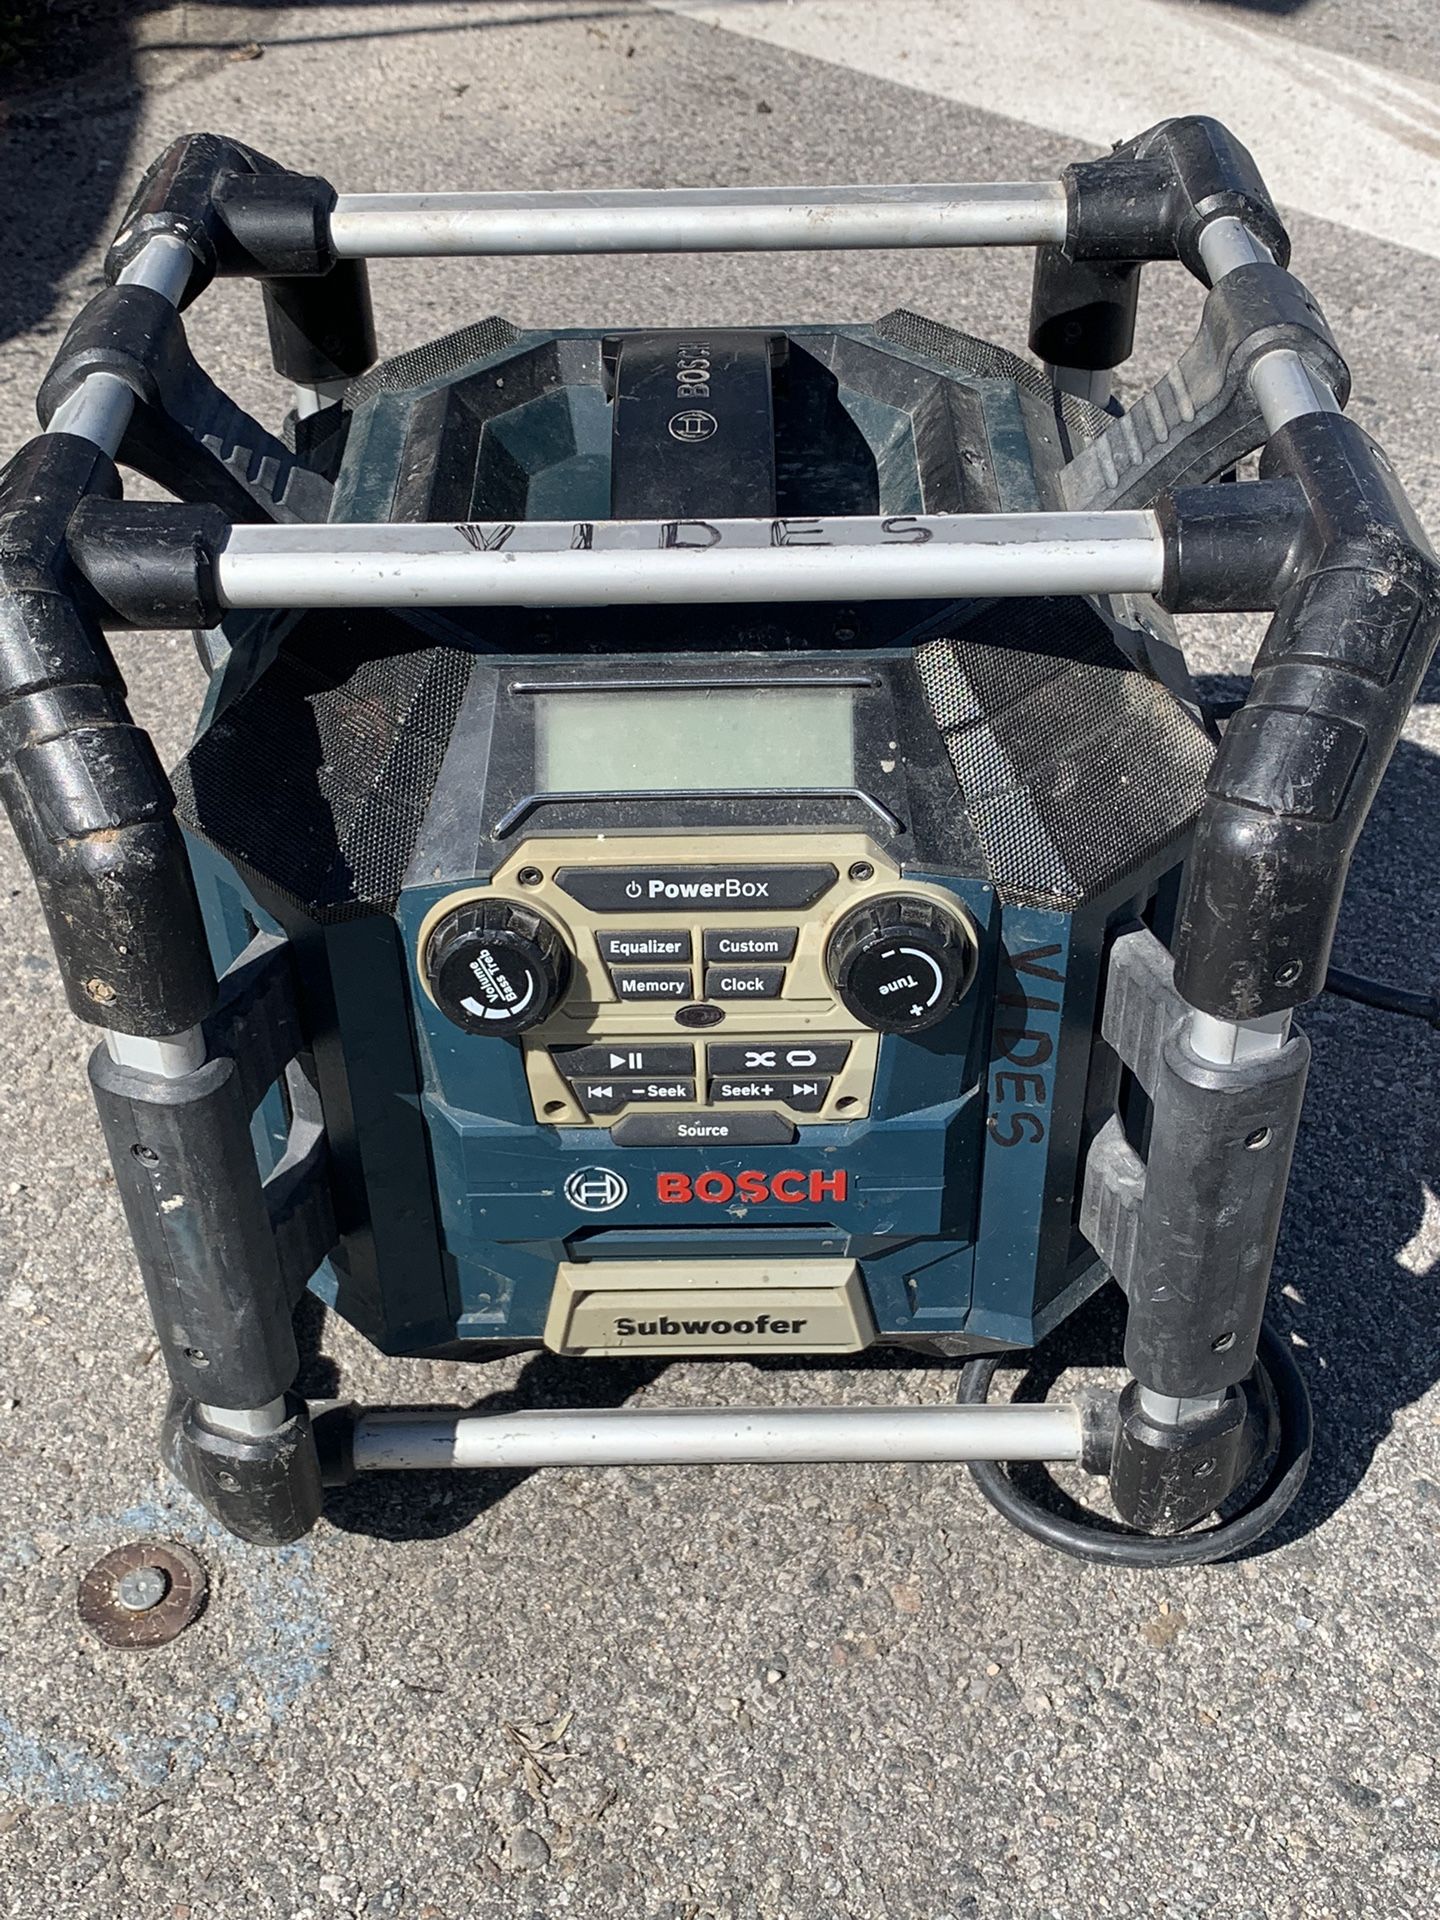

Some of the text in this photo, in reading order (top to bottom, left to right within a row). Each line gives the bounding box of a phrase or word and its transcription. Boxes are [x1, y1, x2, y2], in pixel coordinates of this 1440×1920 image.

[677, 342, 710, 398] BOSCH
[455, 517, 934, 552] VIDES
[648, 881, 769, 899] PowerBox
[609, 939, 682, 956] Equalizer
[718, 939, 778, 954] Custom
[469, 961, 499, 1003] Volume
[479, 949, 518, 1003] Bass Treb
[622, 977, 685, 994] Memory
[721, 976, 764, 992] Clock
[878, 975, 918, 995] Tune
[988, 944, 1067, 1148] VIDES
[677, 1123, 729, 1137] Source
[656, 1169, 848, 1204] BOSCH
[614, 1315, 808, 1336] Subwoofer
